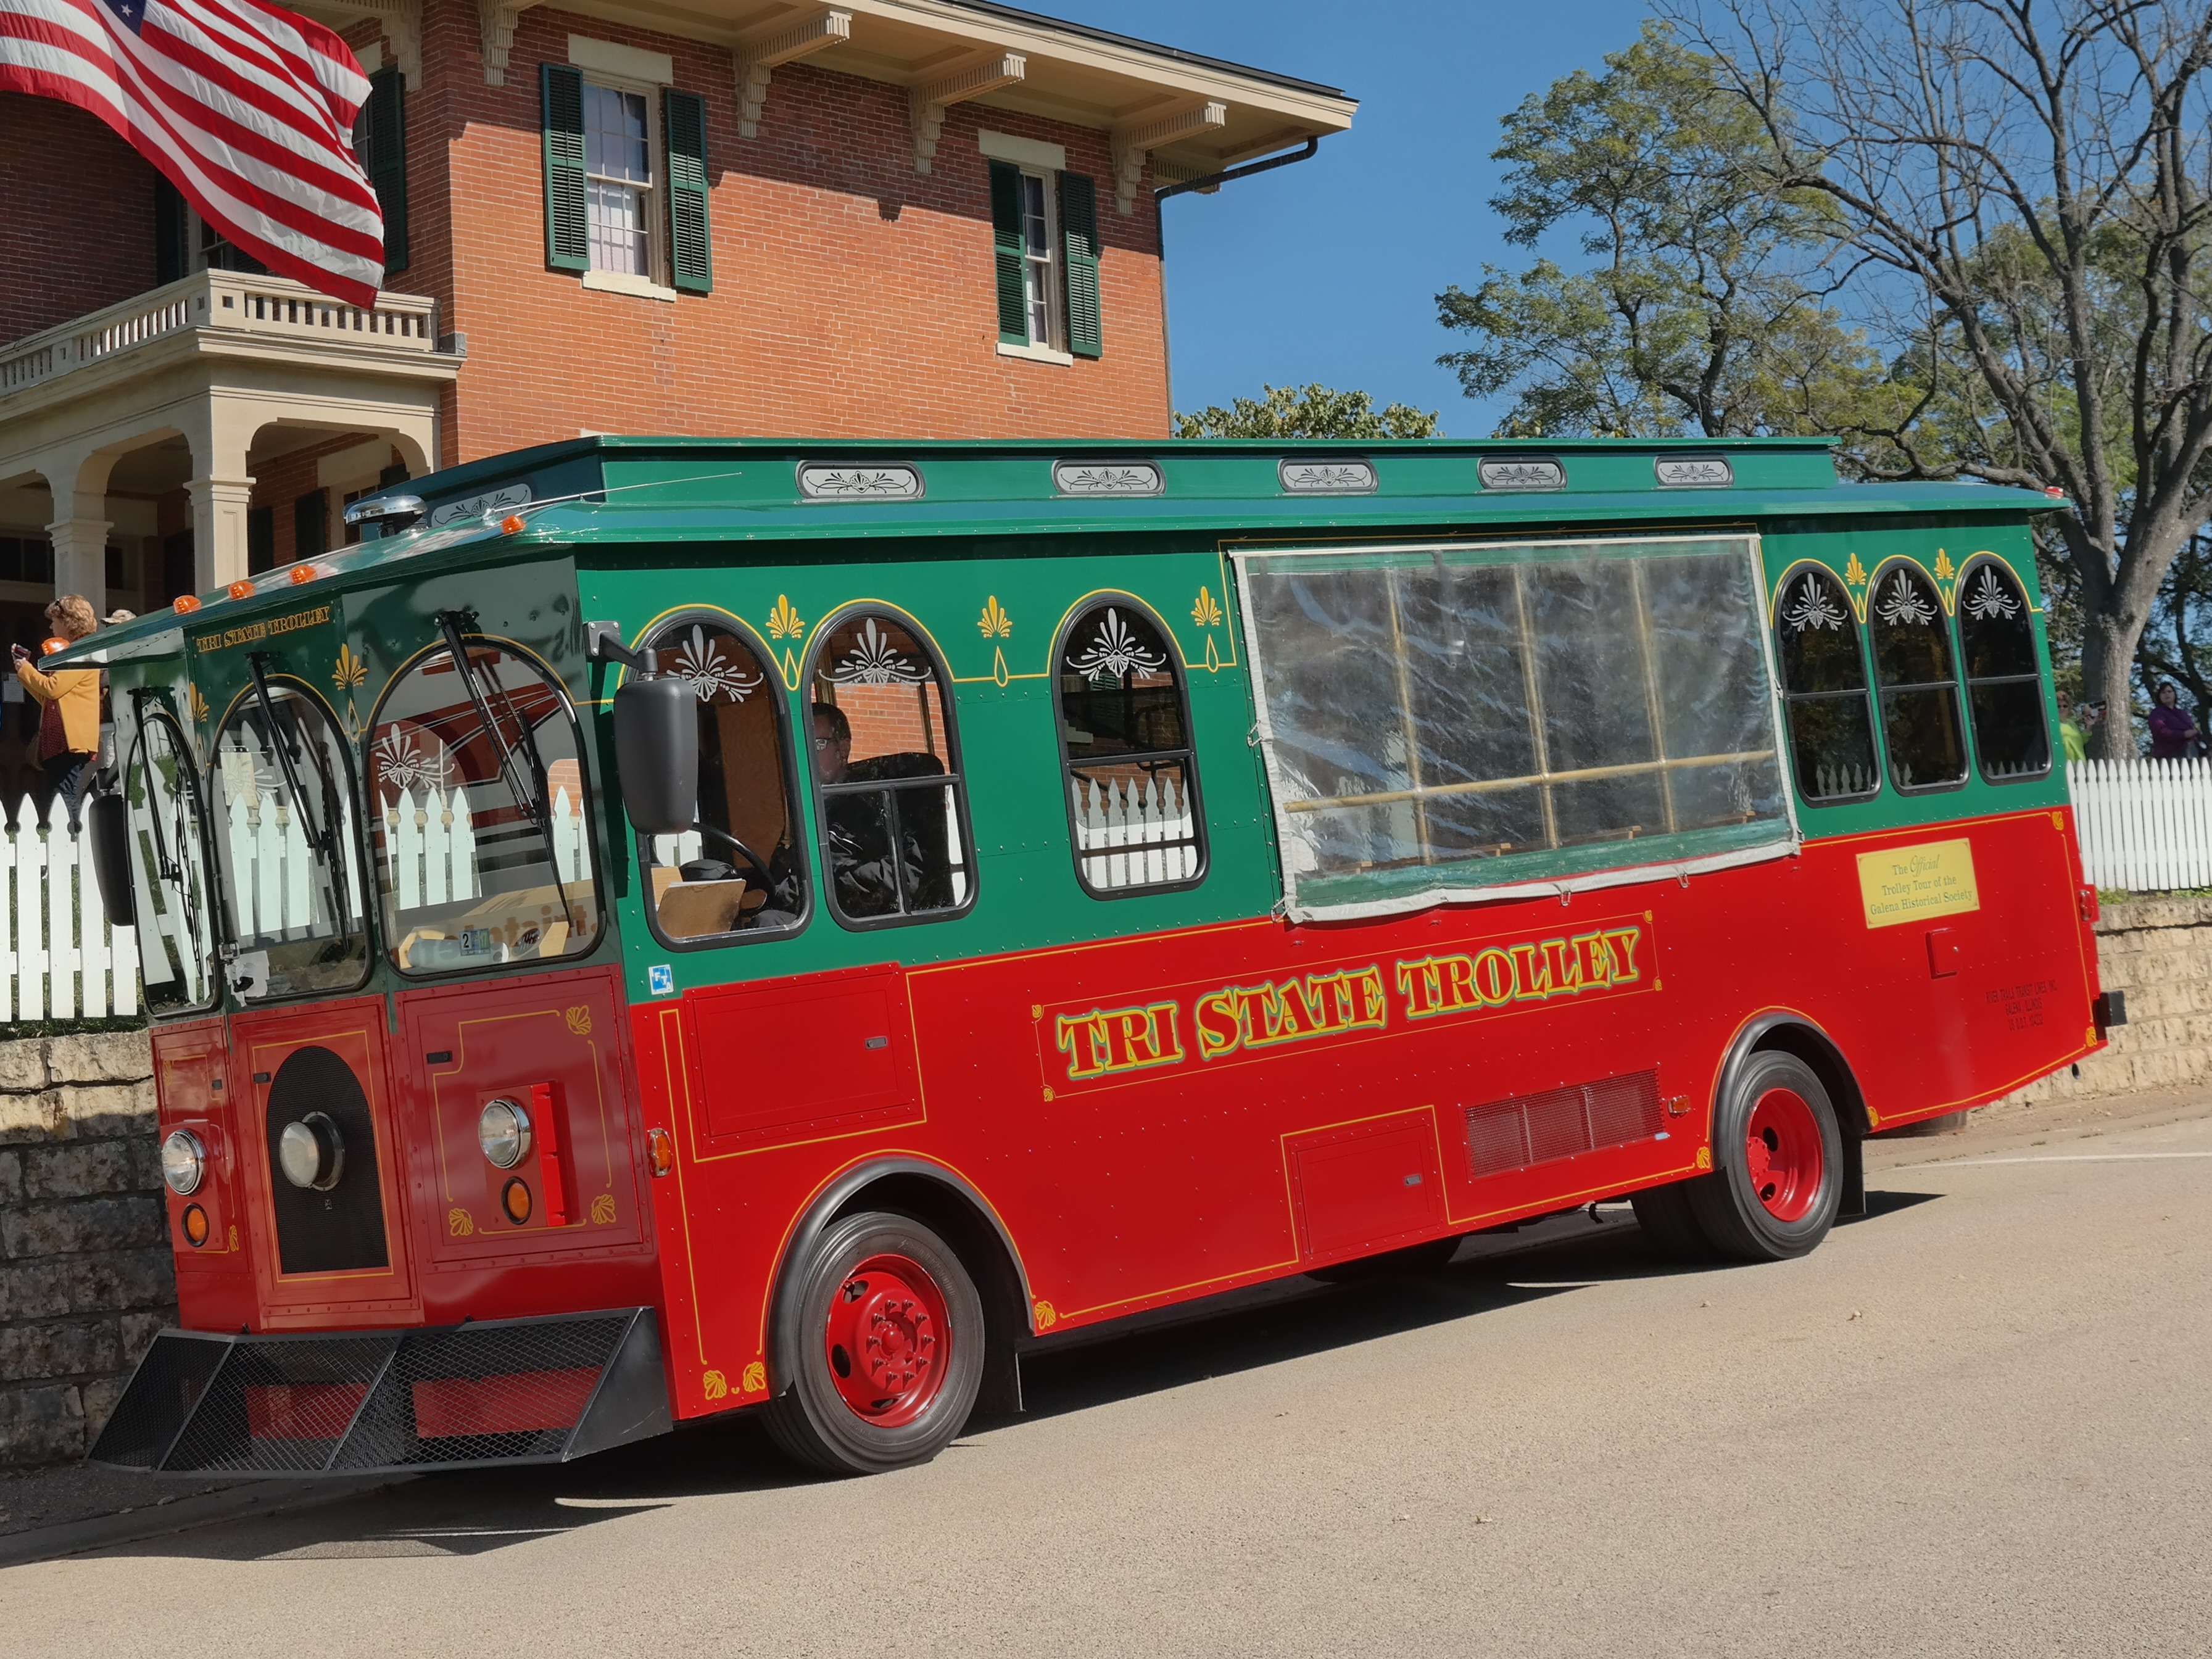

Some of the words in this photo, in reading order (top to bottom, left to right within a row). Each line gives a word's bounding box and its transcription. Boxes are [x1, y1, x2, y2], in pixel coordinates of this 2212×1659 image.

[197, 634, 222, 653] TRI
[224, 623, 266, 647] STATE
[268, 606, 330, 635] TROLLEY
[1892, 865, 1908, 875] The
[1910, 854, 1940, 877] Official
[1882, 883, 1911, 896] Trolley
[1913, 880, 1932, 891] Tour
[1934, 876, 1942, 888] of
[1944, 875, 1957, 886] the
[1870, 903, 1899, 915] Galena
[1901, 893, 1942, 910] Historical
[1944, 890, 1973, 902] Society
[1056, 1003, 1183, 1080] TRI
[1196, 966, 1386, 1060] STATE
[1396, 927, 1640, 1018] TROLLEY
